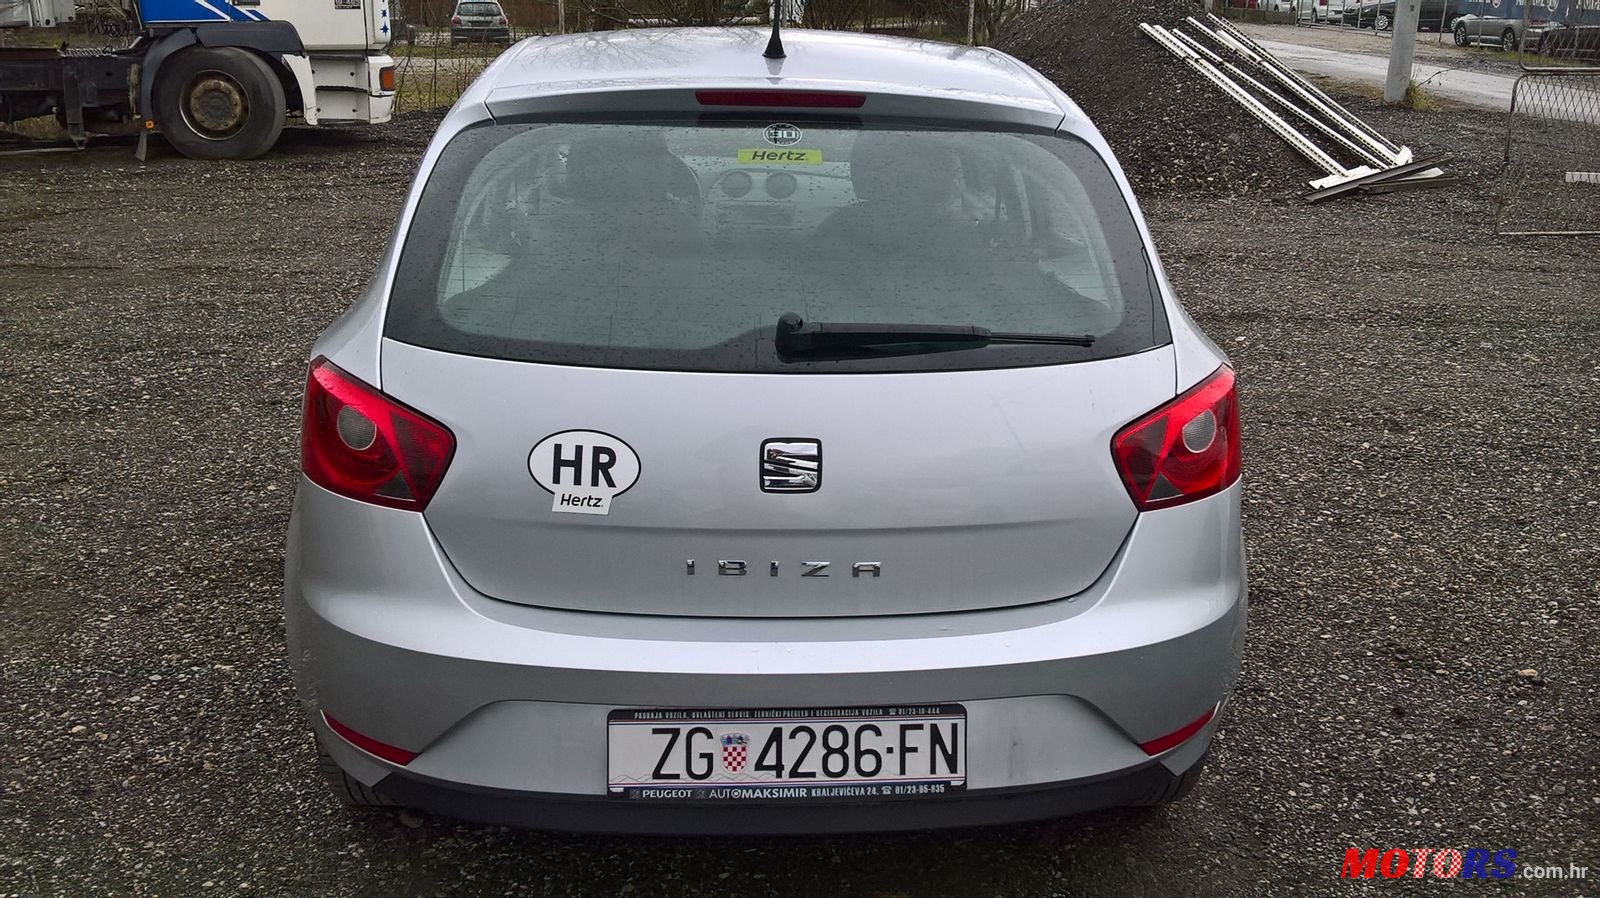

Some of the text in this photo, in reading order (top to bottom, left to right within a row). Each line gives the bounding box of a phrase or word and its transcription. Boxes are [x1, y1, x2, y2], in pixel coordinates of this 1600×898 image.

[752, 151, 807, 161] Hertz
[552, 443, 617, 488] HR
[560, 493, 604, 508] Hertz
[686, 559, 881, 578] IBIZA
[651, 727, 714, 780] ZG
[642, 789, 692, 798] PEUGEOT
[709, 787, 808, 799] AUTOMAKSIMIR
